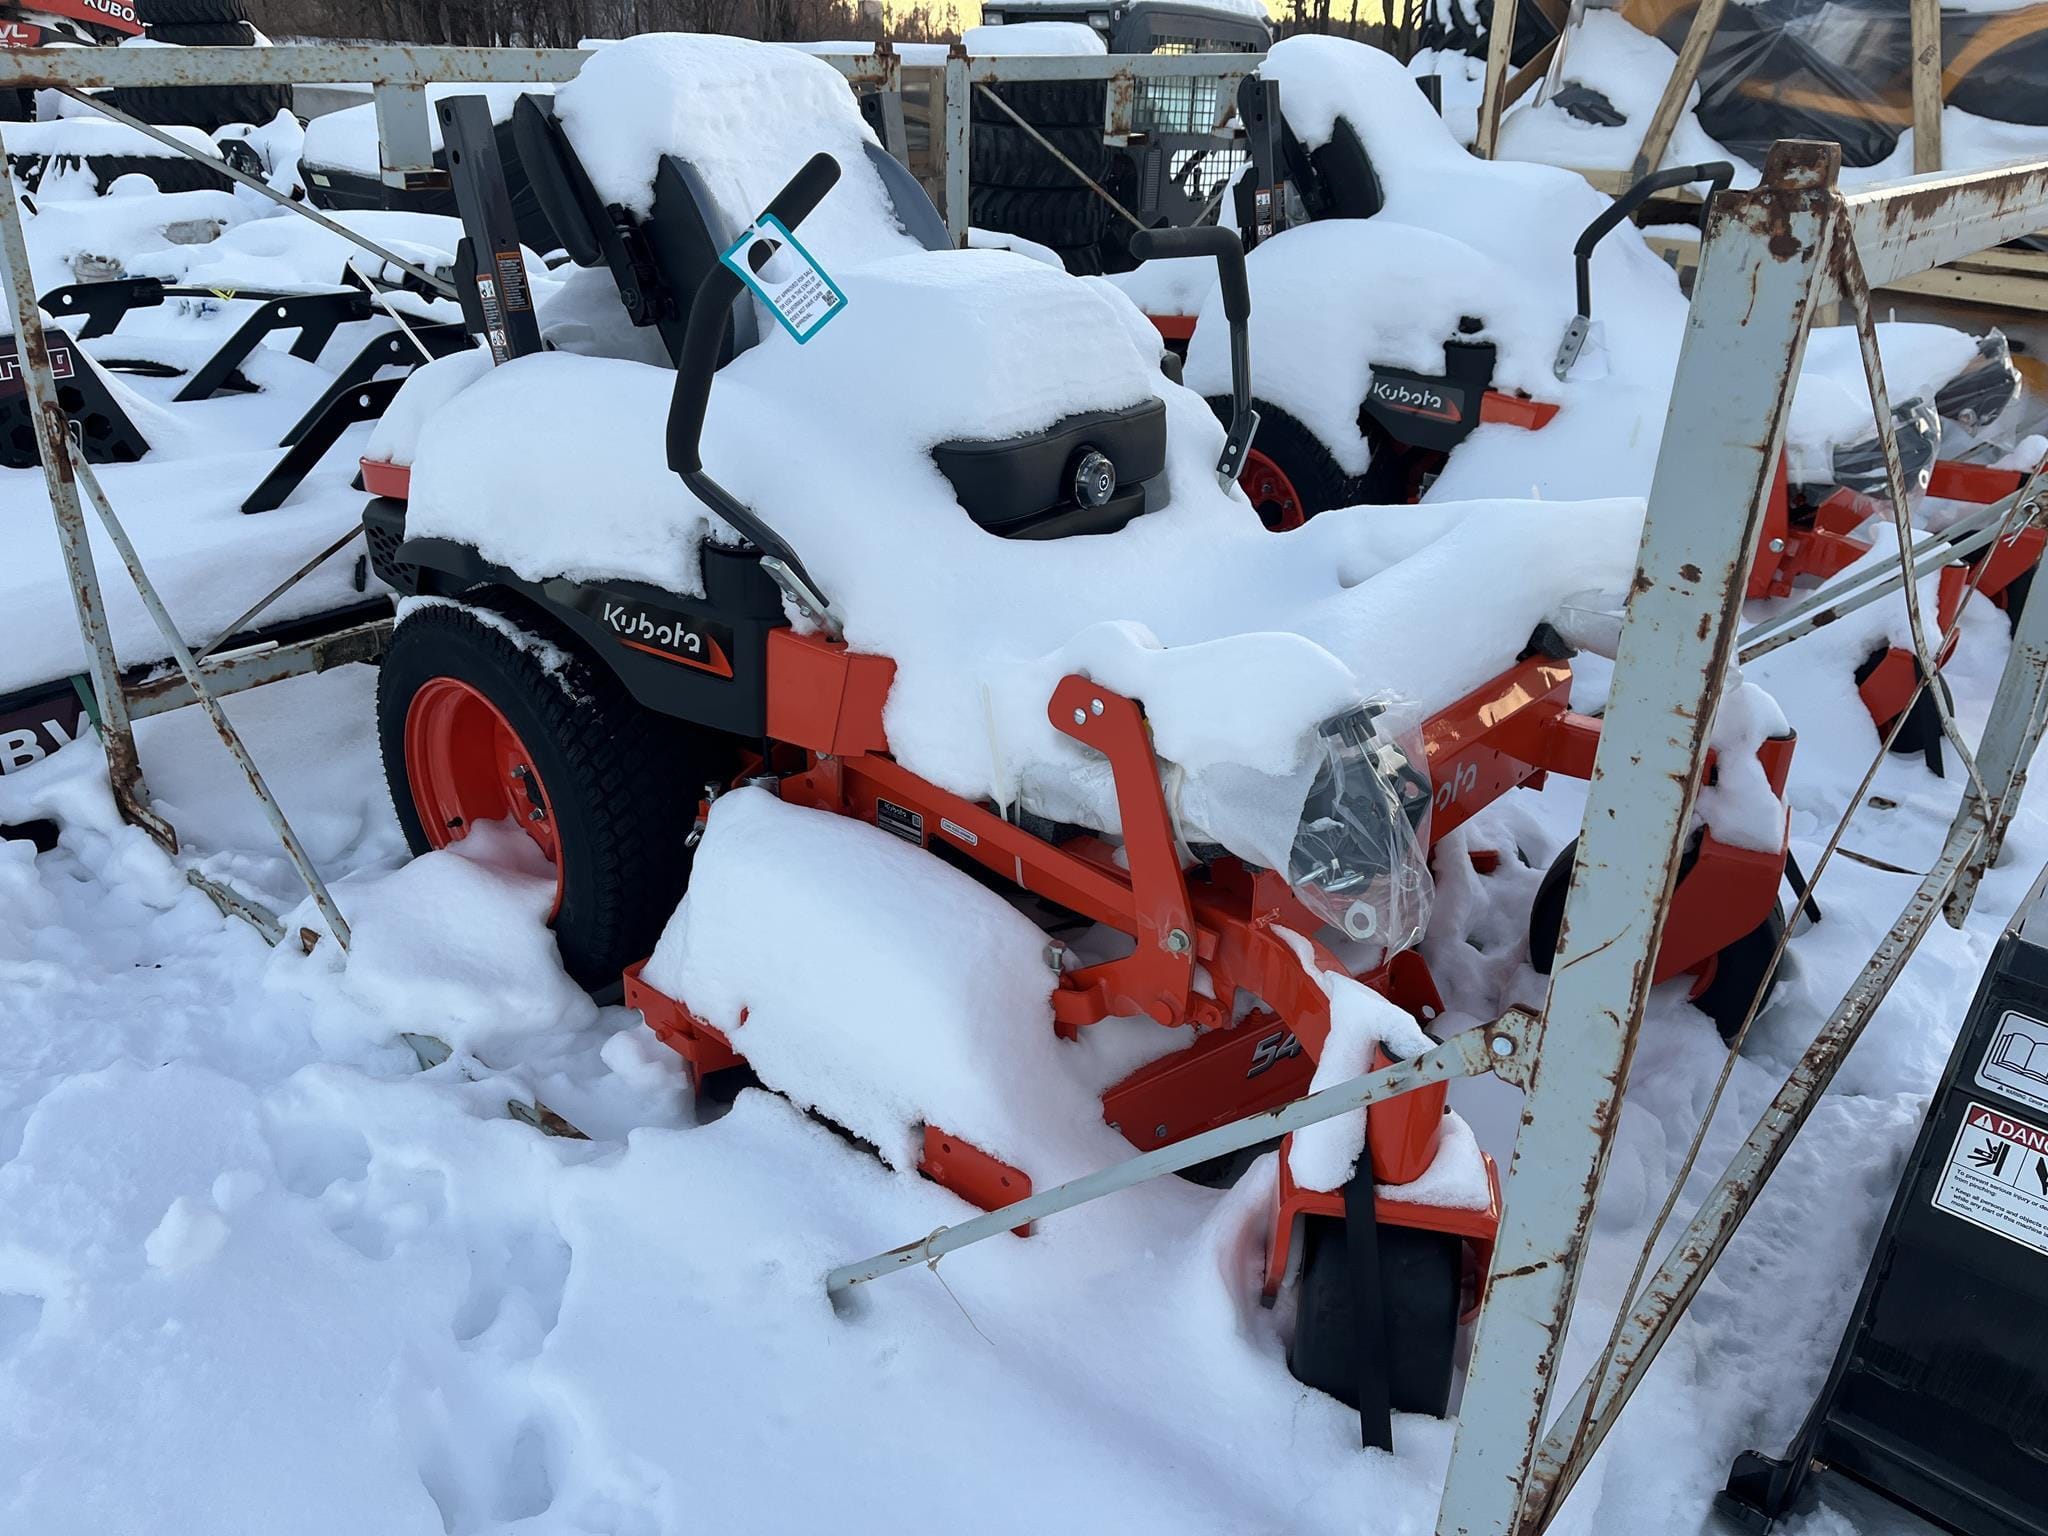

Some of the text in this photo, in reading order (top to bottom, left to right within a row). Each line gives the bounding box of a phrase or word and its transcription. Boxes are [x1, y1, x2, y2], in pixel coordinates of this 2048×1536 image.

[83, 0, 141, 26] KUBO
[774, 296, 783, 304] NOT
[781, 281, 799, 298] APPROVED
[803, 267, 813, 277] SALE
[784, 298, 792, 306] USE
[794, 288, 803, 296] THE
[801, 280, 812, 290] STATE
[806, 286, 816, 296] THIS
[790, 312, 800, 322] DOES
[798, 306, 806, 314] NOT
[805, 298, 815, 309] HAVE
[1374, 382, 1441, 408] Kubota
[603, 602, 701, 653] Kubota
[1435, 762, 1477, 811] ota
[1954, 1175, 1969, 1185] from
[1965, 1173, 1989, 1187] prevent
[1989, 1183, 2012, 1196] serious
[2013, 1192, 2031, 1204] injury
[1950, 1200, 1973, 1212] motion.
[1953, 1194, 1969, 1204] while
[1970, 1200, 1981, 1209] any
[1981, 1206, 1995, 1215] part
[2003, 1214, 2015, 1223] this
[2015, 1221, 2042, 1235] machine
[1955, 1187, 1971, 1198] Keep
[1980, 1198, 2005, 1212] persons
[2006, 1209, 2018, 1218] and
[2018, 1215, 2042, 1228] objects
